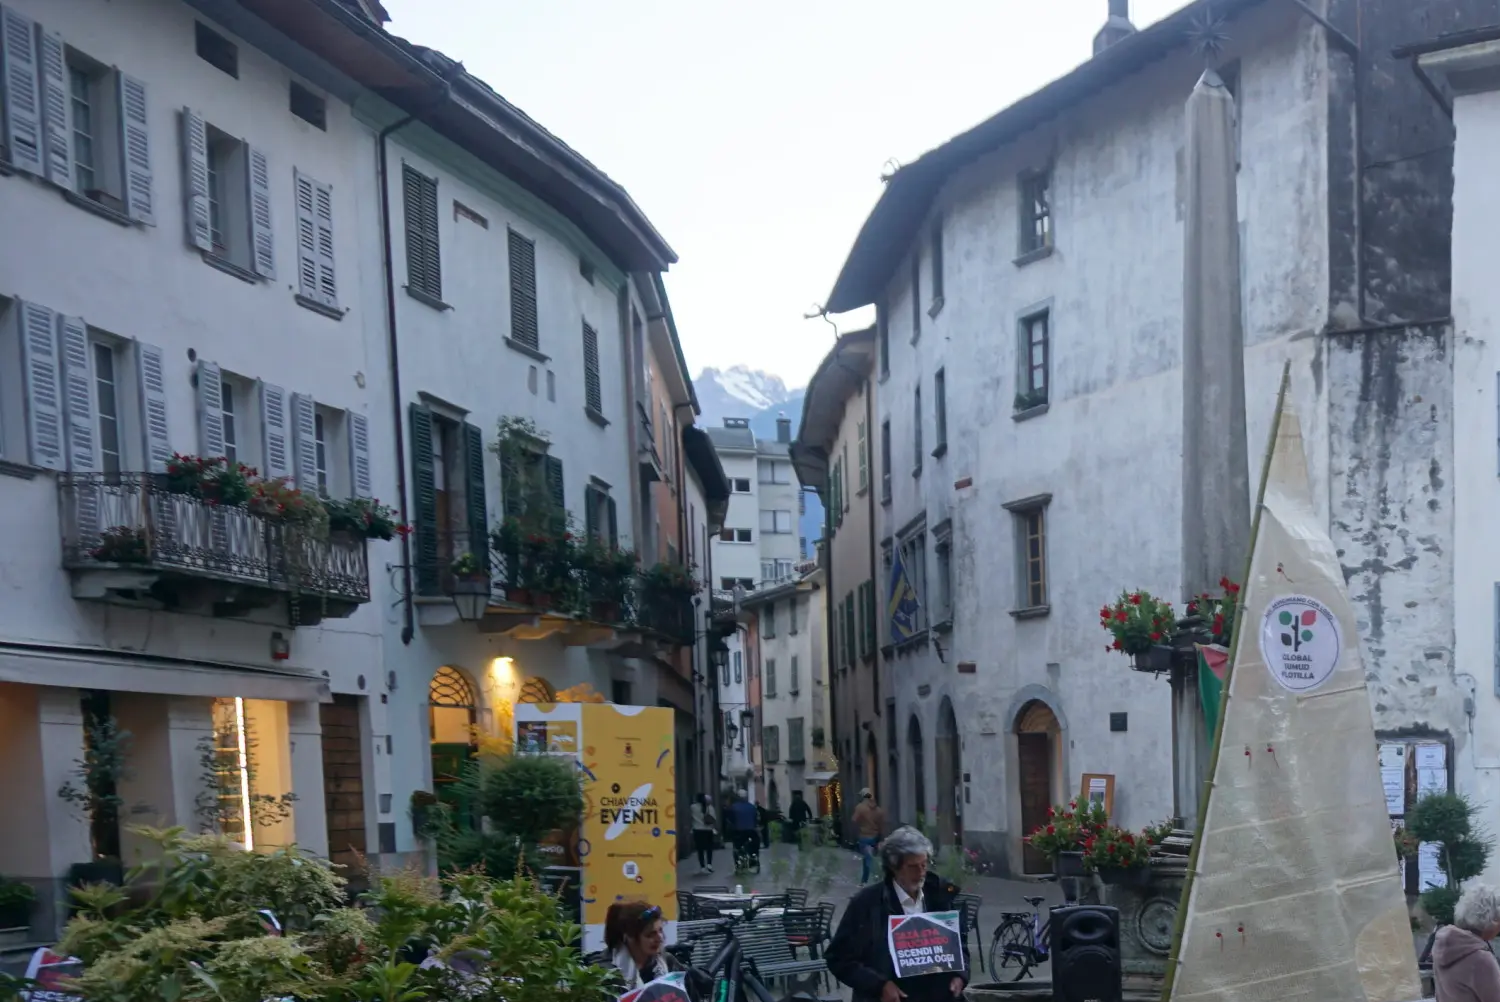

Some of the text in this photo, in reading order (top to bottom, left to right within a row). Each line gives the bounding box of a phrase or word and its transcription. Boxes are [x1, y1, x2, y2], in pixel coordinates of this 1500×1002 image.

[600, 797, 658, 807] CHIAVENNA
[600, 809, 658, 825] EVENTI
[897, 945, 943, 958] SCENDI IN
[900, 954, 954, 967] PIAZZA OGGI
